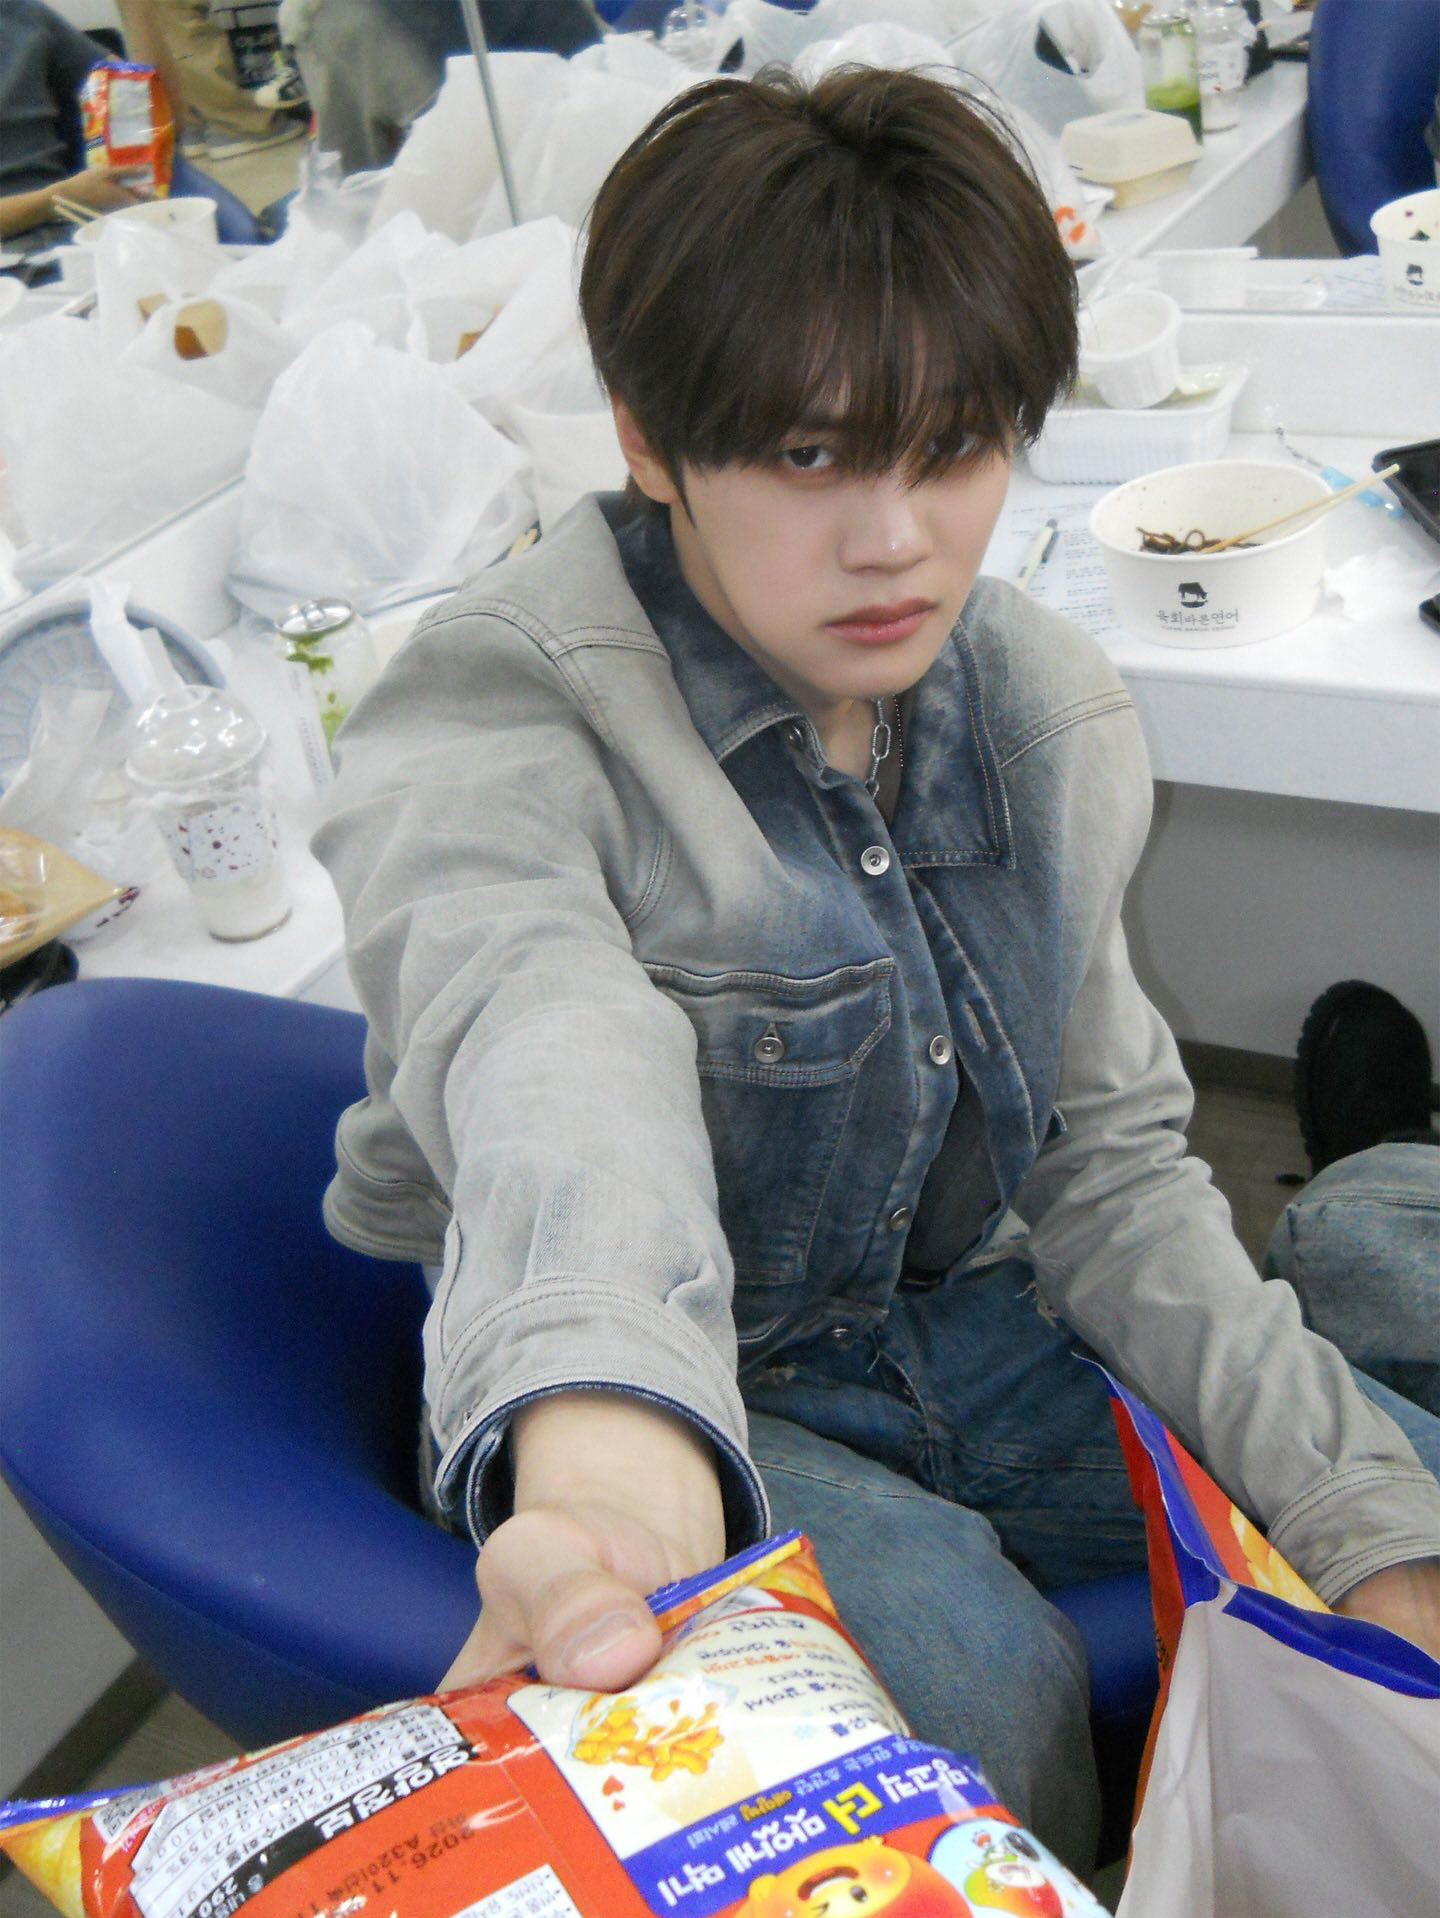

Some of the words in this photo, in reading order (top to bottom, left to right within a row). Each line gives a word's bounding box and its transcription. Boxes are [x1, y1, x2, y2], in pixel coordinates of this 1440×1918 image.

[842, 1746, 892, 1775] 만드는
[313, 1744, 470, 1840] 영양정보
[792, 1766, 841, 1796] 초간단
[821, 1781, 882, 1834] 더
[684, 1812, 739, 1850] 레시피
[724, 1808, 827, 1873] 맛있게
[656, 1865, 726, 1905] 먹기
